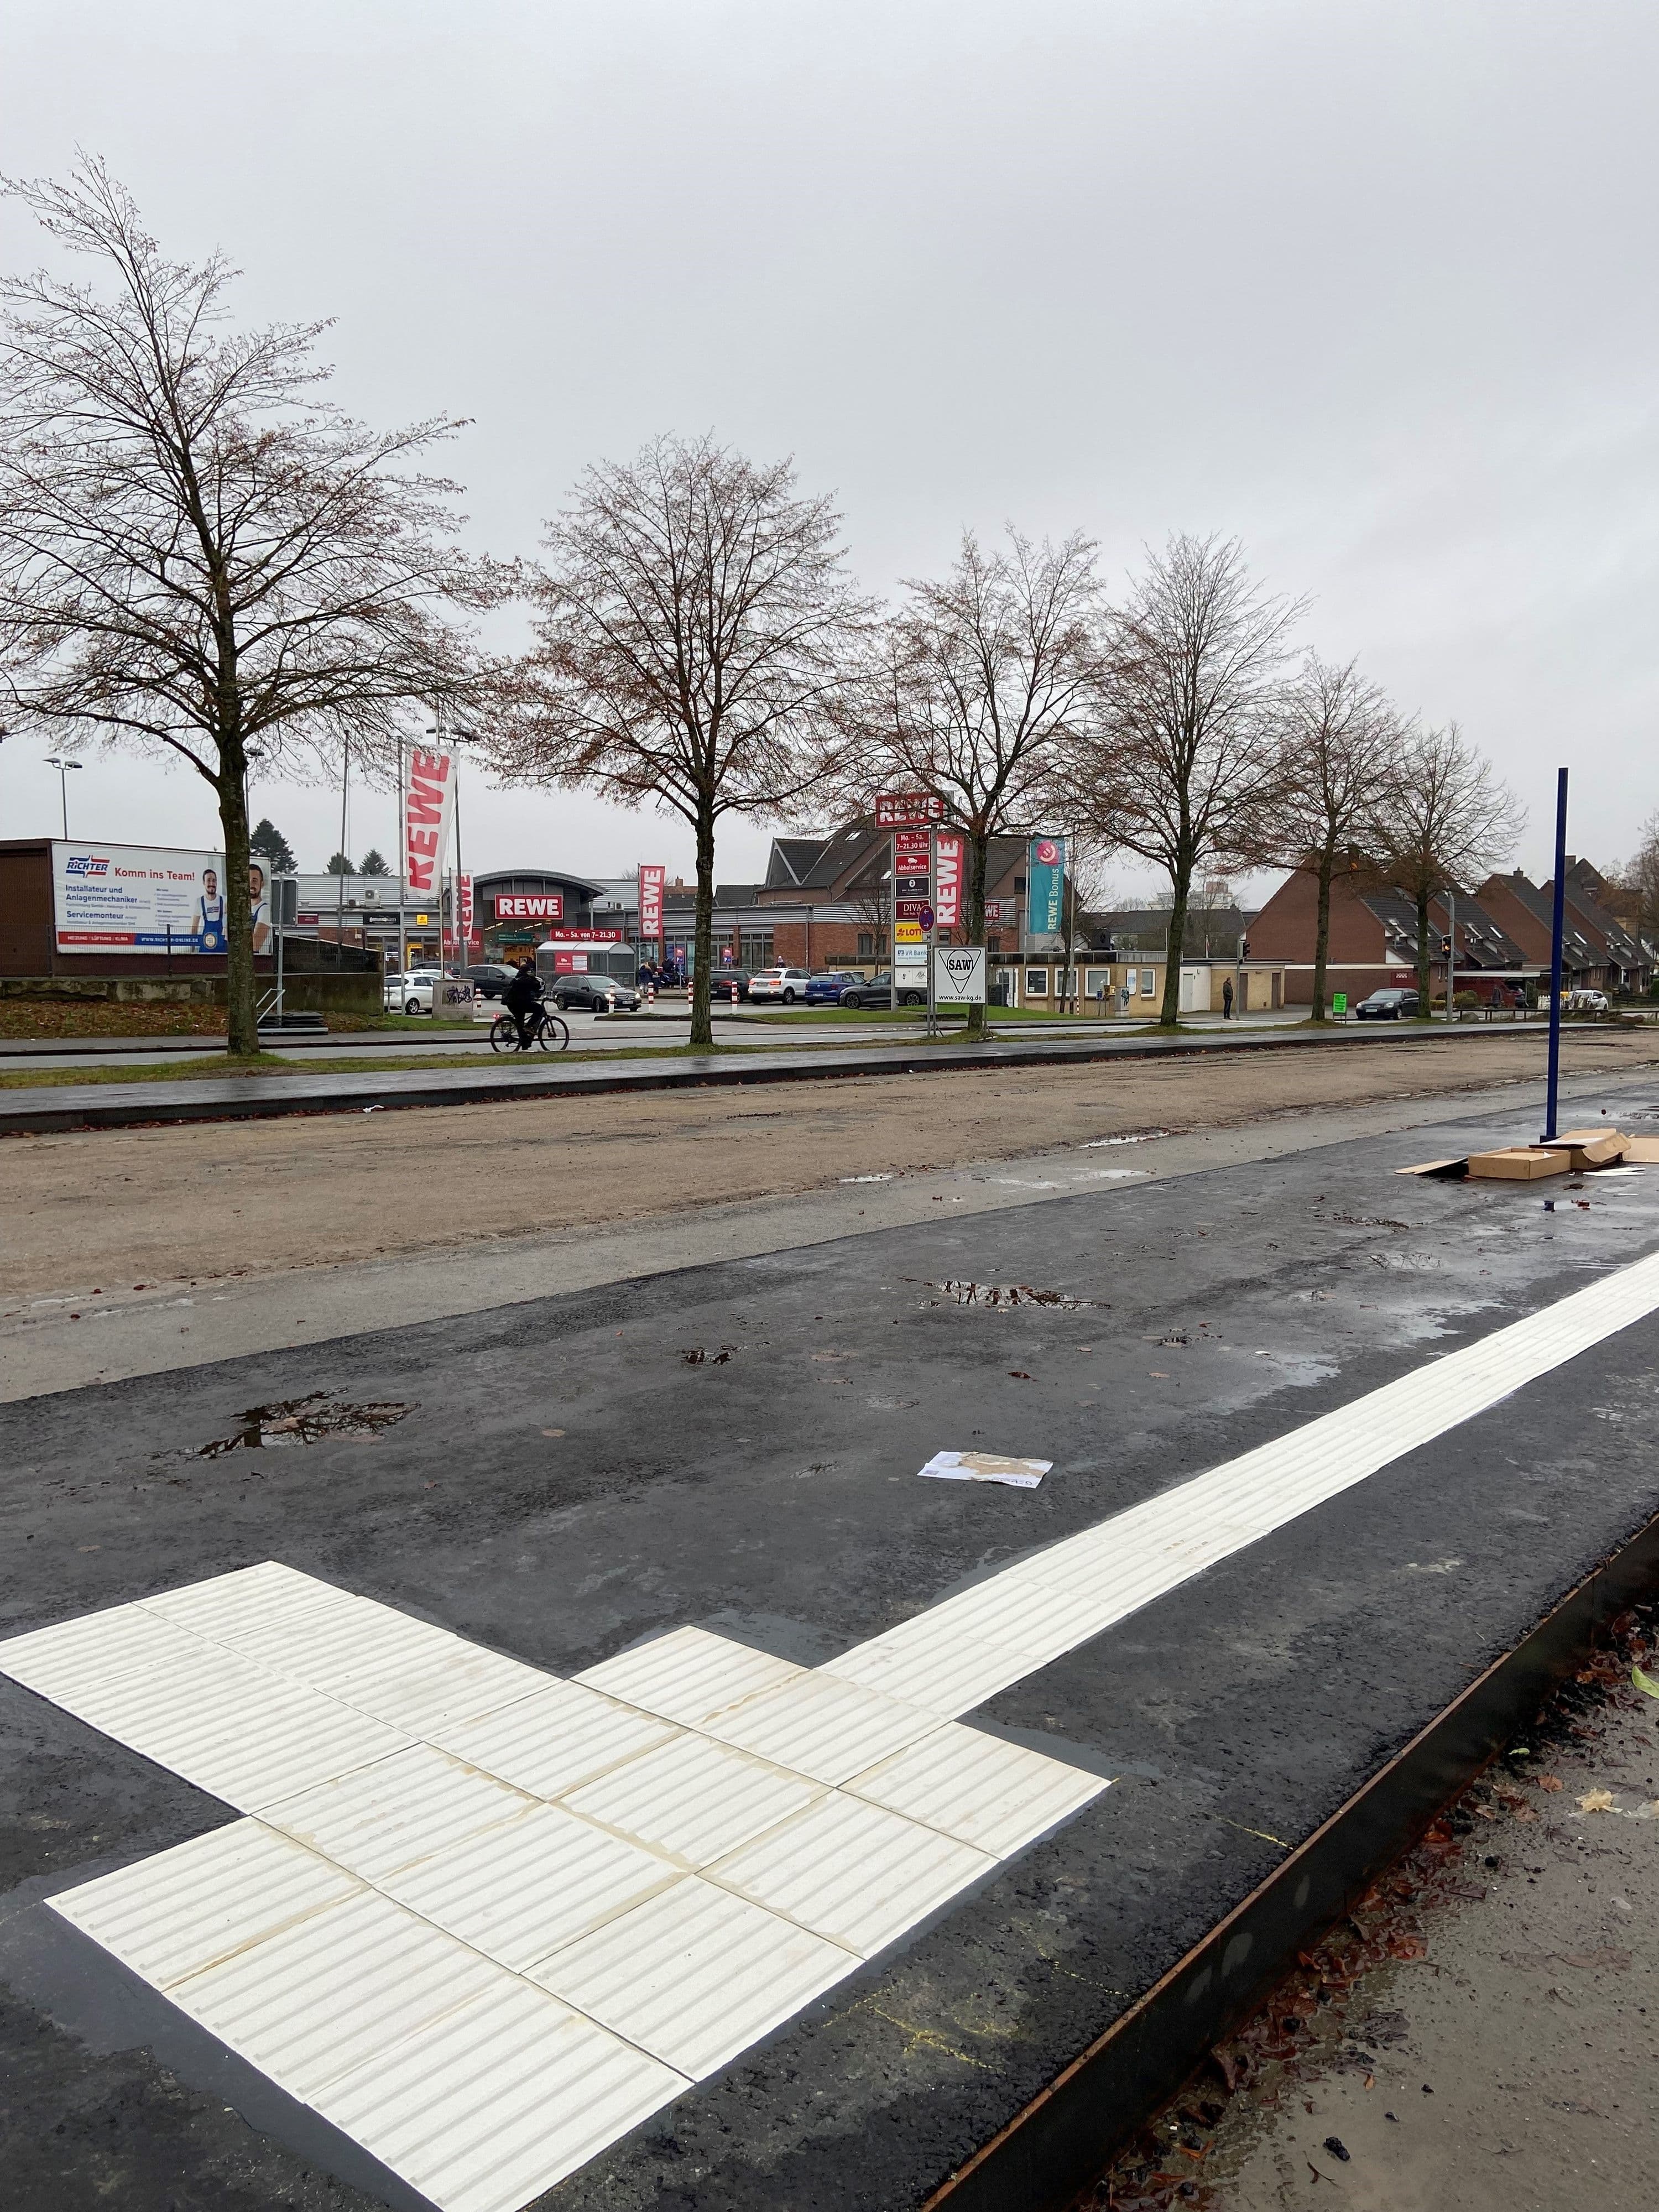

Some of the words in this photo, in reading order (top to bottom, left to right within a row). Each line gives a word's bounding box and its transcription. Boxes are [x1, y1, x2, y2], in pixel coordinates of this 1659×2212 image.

[879, 796, 940, 822] REWE
[408, 749, 450, 890] REWE
[114, 867, 146, 878] Komm
[149, 869, 164, 879] ins
[166, 870, 195, 881] Team!
[937, 840, 958, 924] REWE
[1049, 868, 1060, 896] Bonus
[65, 884, 107, 893] Installateur
[66, 894, 138, 903] Anlagenmechaniker
[456, 875, 472, 937] REWE
[499, 898, 560, 916] REWE
[643, 870, 661, 935] REWE
[67, 911, 124, 919] Servicemonteur
[904, 904, 921, 912] DIVA
[984, 904, 999, 917] WE
[1047, 899, 1058, 930] REWE
[948, 959, 972, 970] SAW
